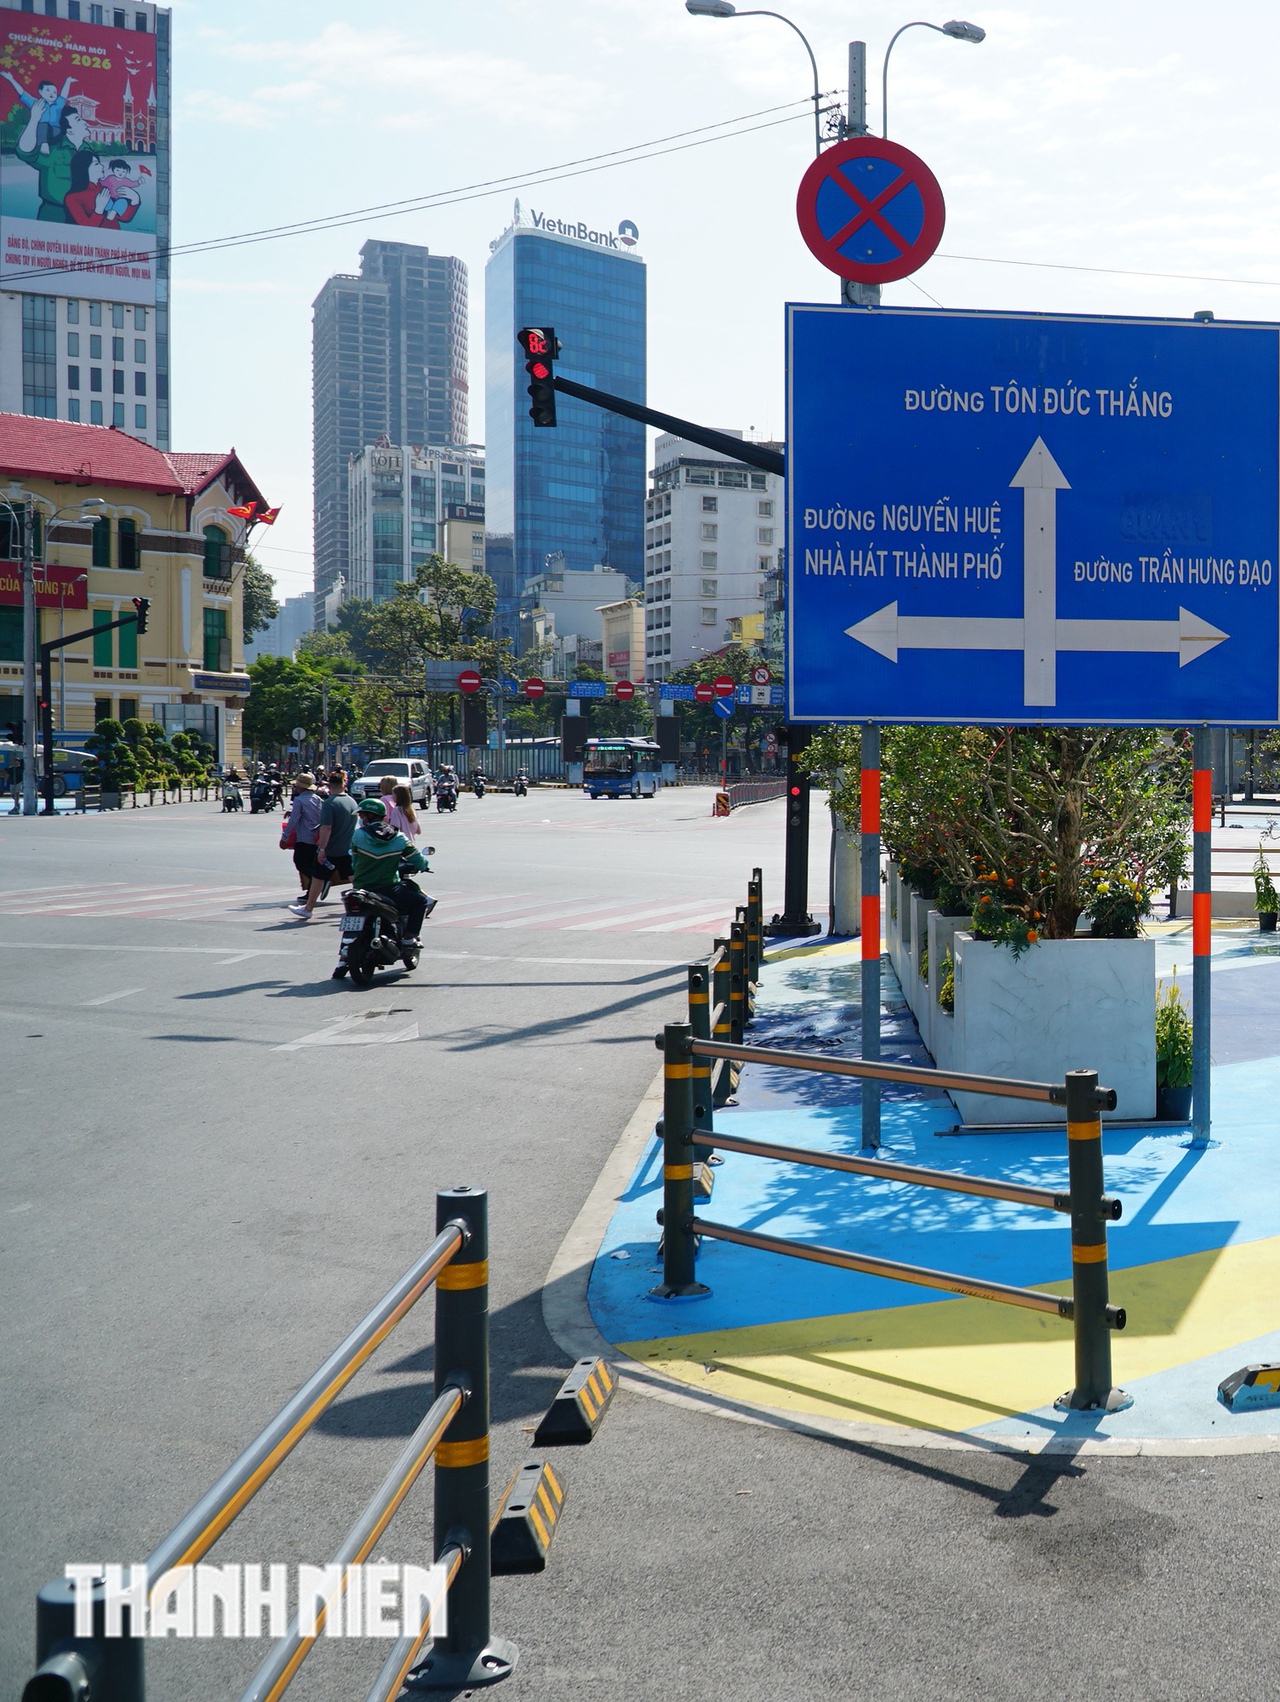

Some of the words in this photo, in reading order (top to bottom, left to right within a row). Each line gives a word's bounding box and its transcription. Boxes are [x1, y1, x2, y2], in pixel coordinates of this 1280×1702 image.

[71, 53, 112, 70] 2026
[530, 208, 618, 249] VietinBank
[904, 383, 984, 413] ĐƯỜNG
[990, 379, 1037, 414] TÔN
[1043, 379, 1091, 416] ĐỨC
[1095, 376, 1173, 418] THẮNG
[803, 503, 875, 532] ĐƯỜNG
[883, 496, 958, 533] NGUYỄN
[964, 501, 1001, 540] HUỆ
[805, 541, 846, 577] NHÀ
[850, 542, 888, 577] HÁT
[892, 543, 958, 579] THÀNH
[963, 542, 1004, 580] PHỐ
[1073, 556, 1133, 583] ĐƯỜNG
[1138, 547, 1184, 584] TRẦN
[1188, 556, 1235, 585] HƯNG
[1238, 559, 1273, 592] ĐẠO
[0, 574, 21, 592] CỦA
[61, 582, 75, 596] TA
